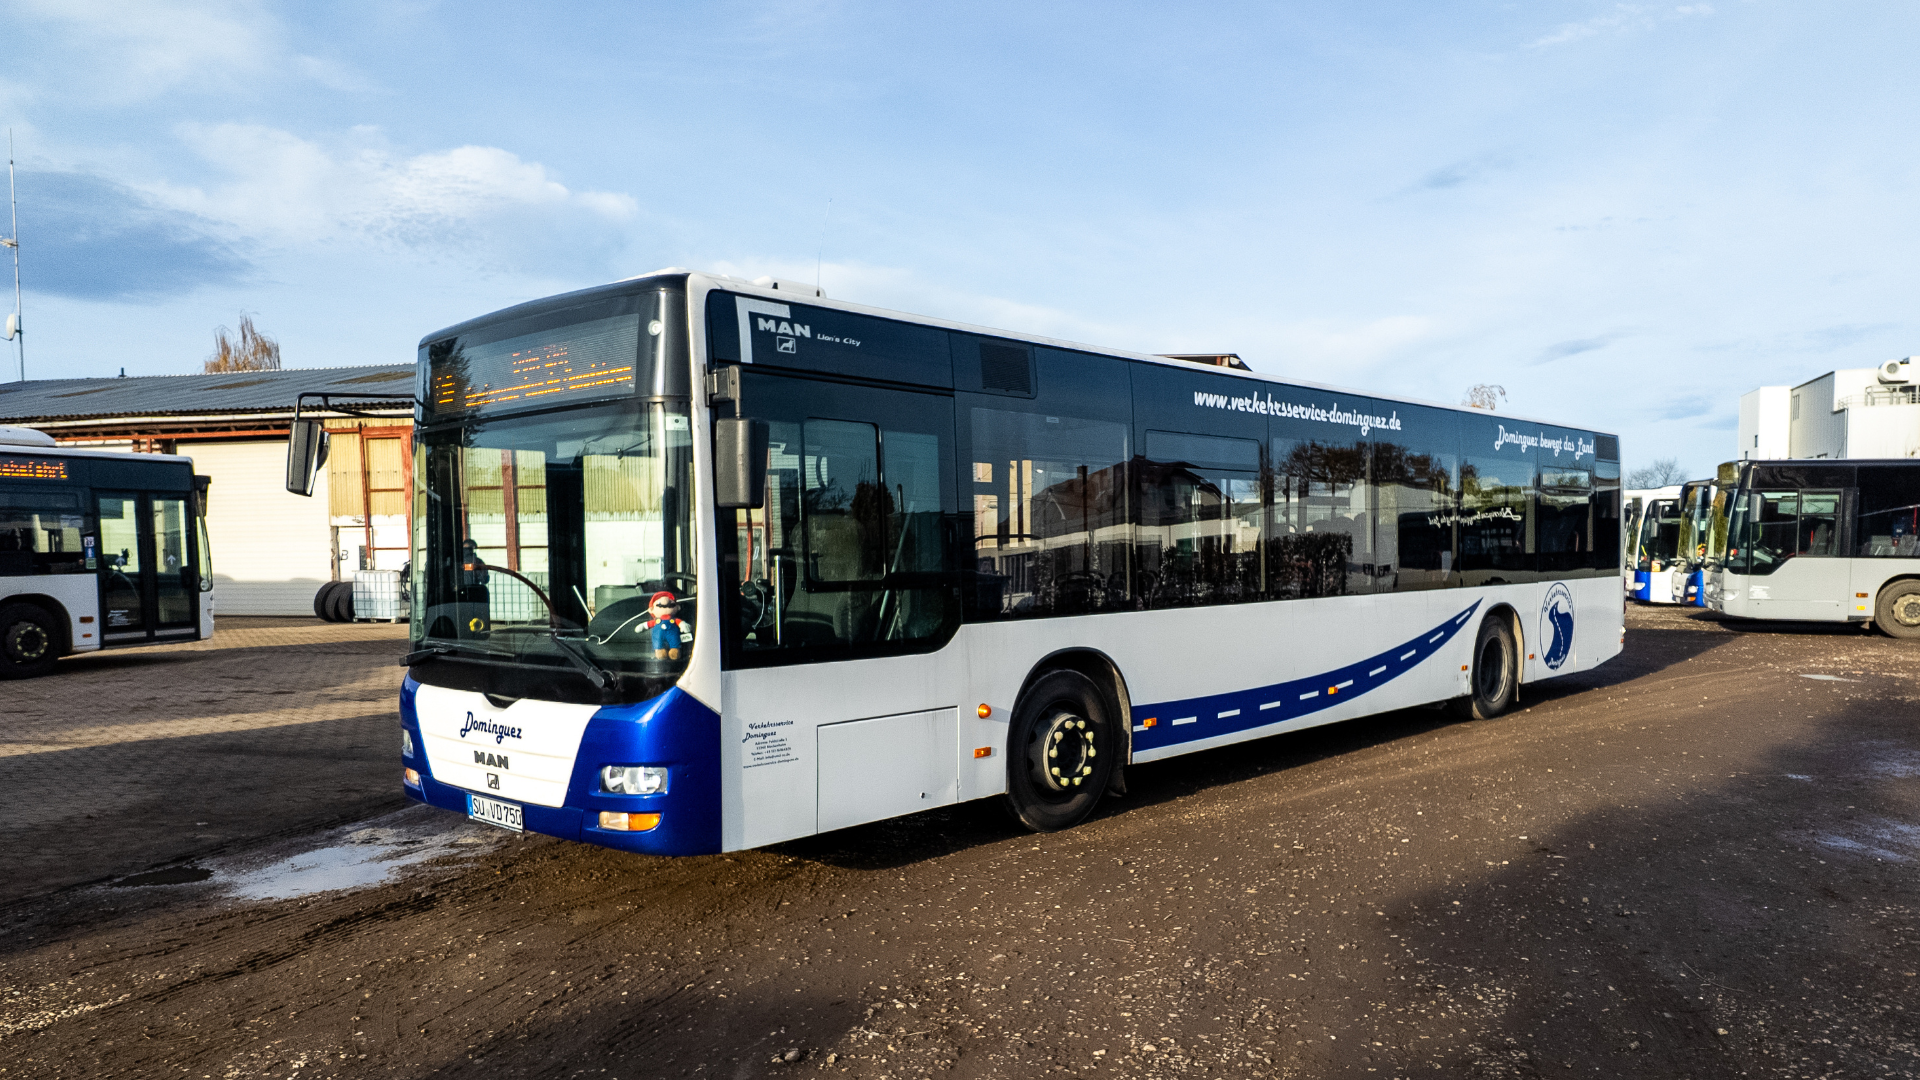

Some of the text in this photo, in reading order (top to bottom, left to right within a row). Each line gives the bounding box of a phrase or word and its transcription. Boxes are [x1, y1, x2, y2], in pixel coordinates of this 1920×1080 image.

[757, 317, 811, 338] MAN
[817, 333, 861, 347] Lion's City
[1194, 391, 1402, 436] www.verkehrsservice-dominguez.de
[1494, 424, 1594, 460] Dominguez bewegt das Land
[460, 711, 522, 744] Dominguez
[474, 750, 509, 769] MAN
[473, 797, 485, 816] SU
